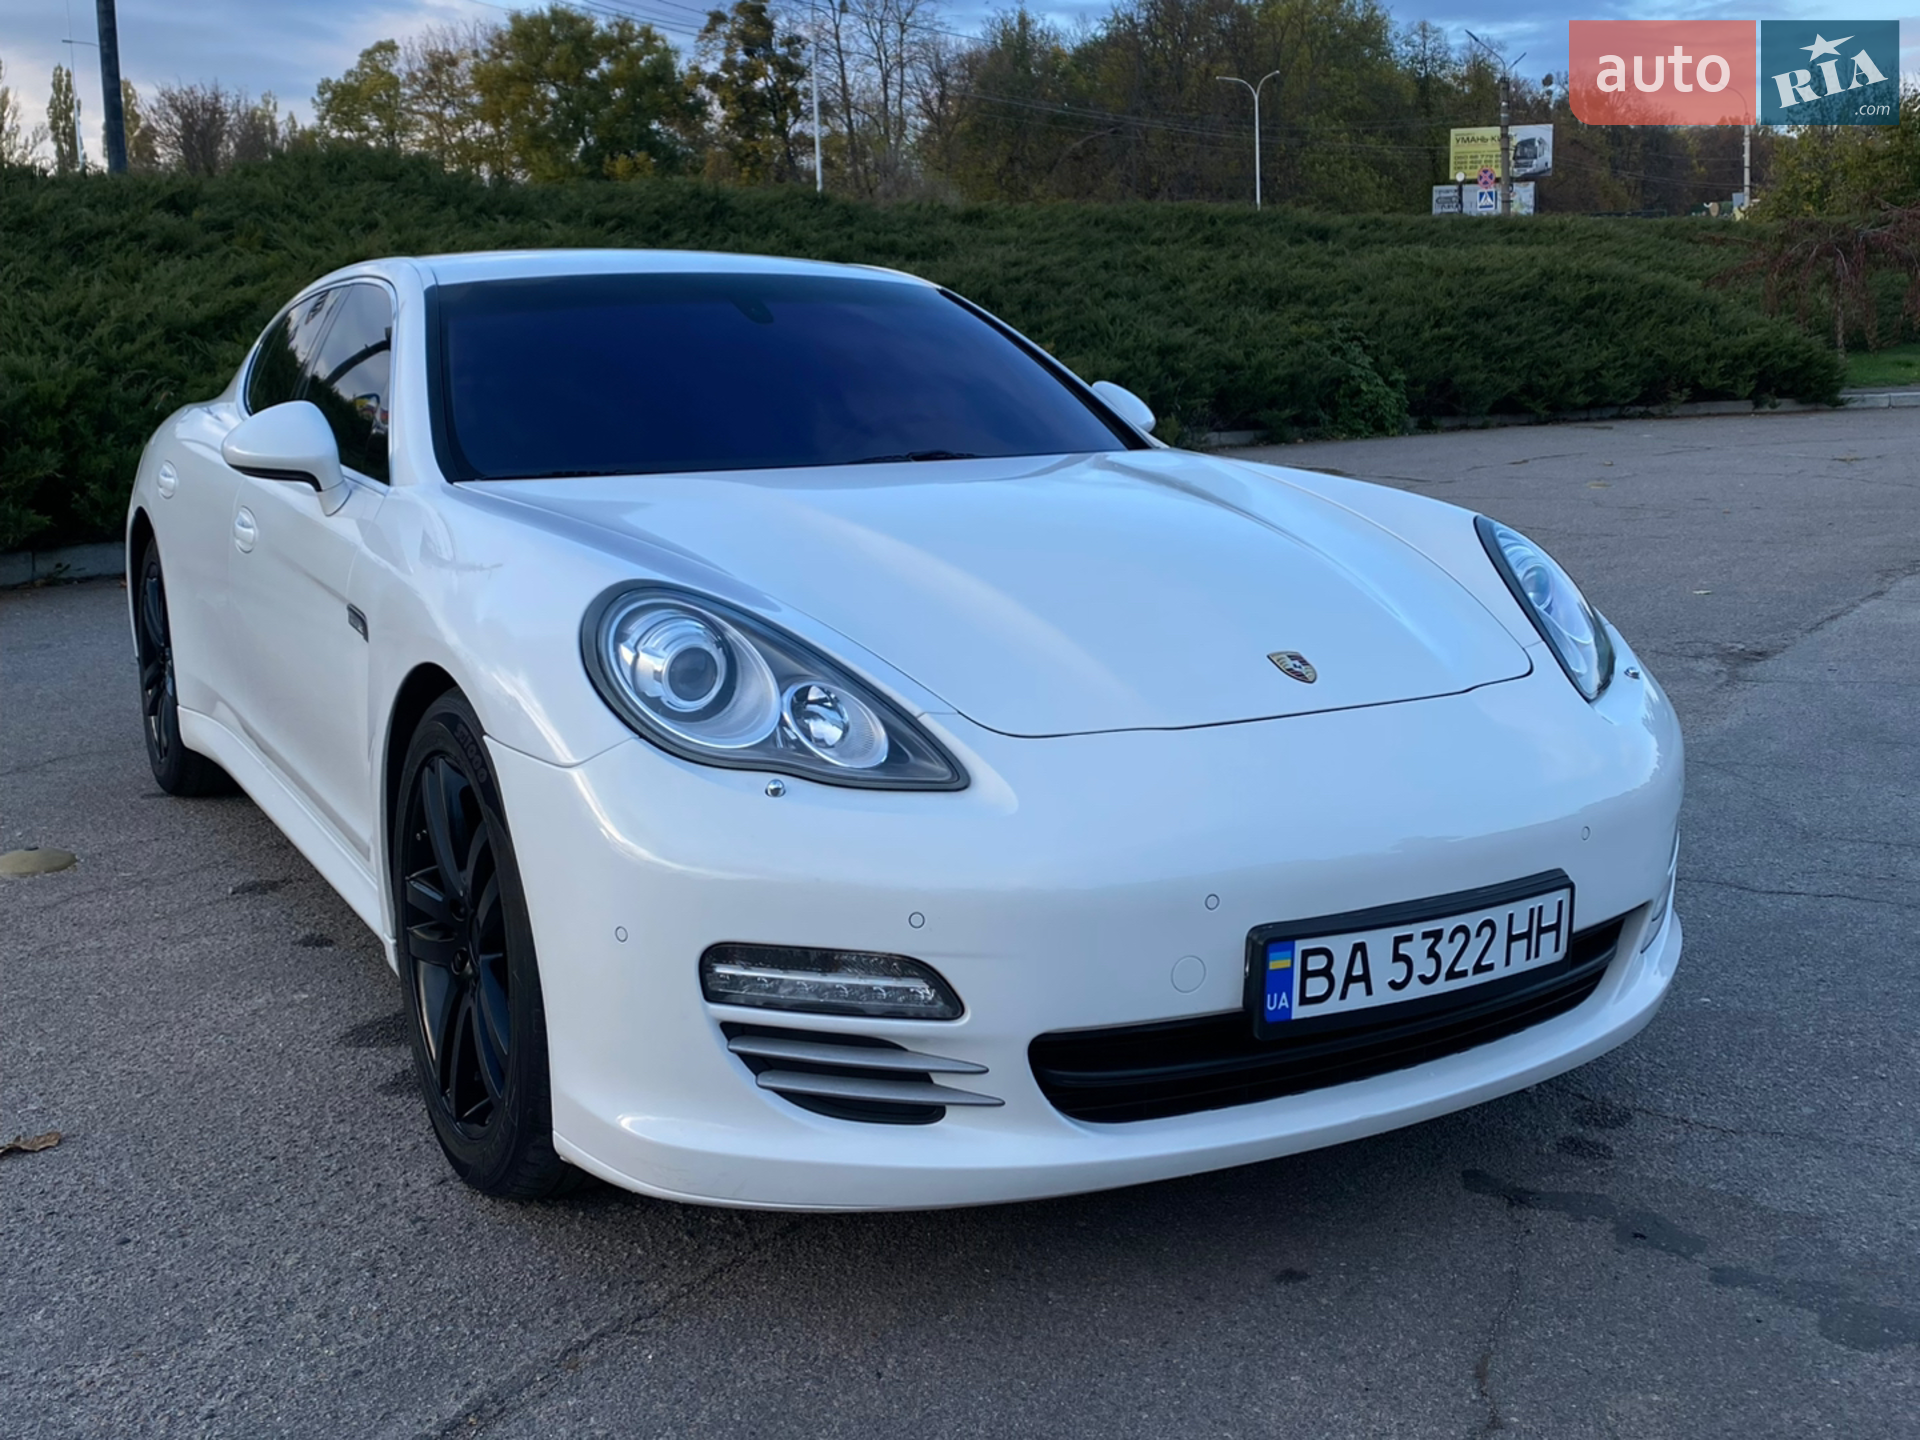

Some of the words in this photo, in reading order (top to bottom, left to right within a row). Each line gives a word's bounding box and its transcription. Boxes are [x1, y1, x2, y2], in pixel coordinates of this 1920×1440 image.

[1298, 940, 1373, 1007] BA
[1387, 918, 1497, 991] 5322
[1504, 897, 1564, 967] HH
[1266, 991, 1289, 1011] UA
